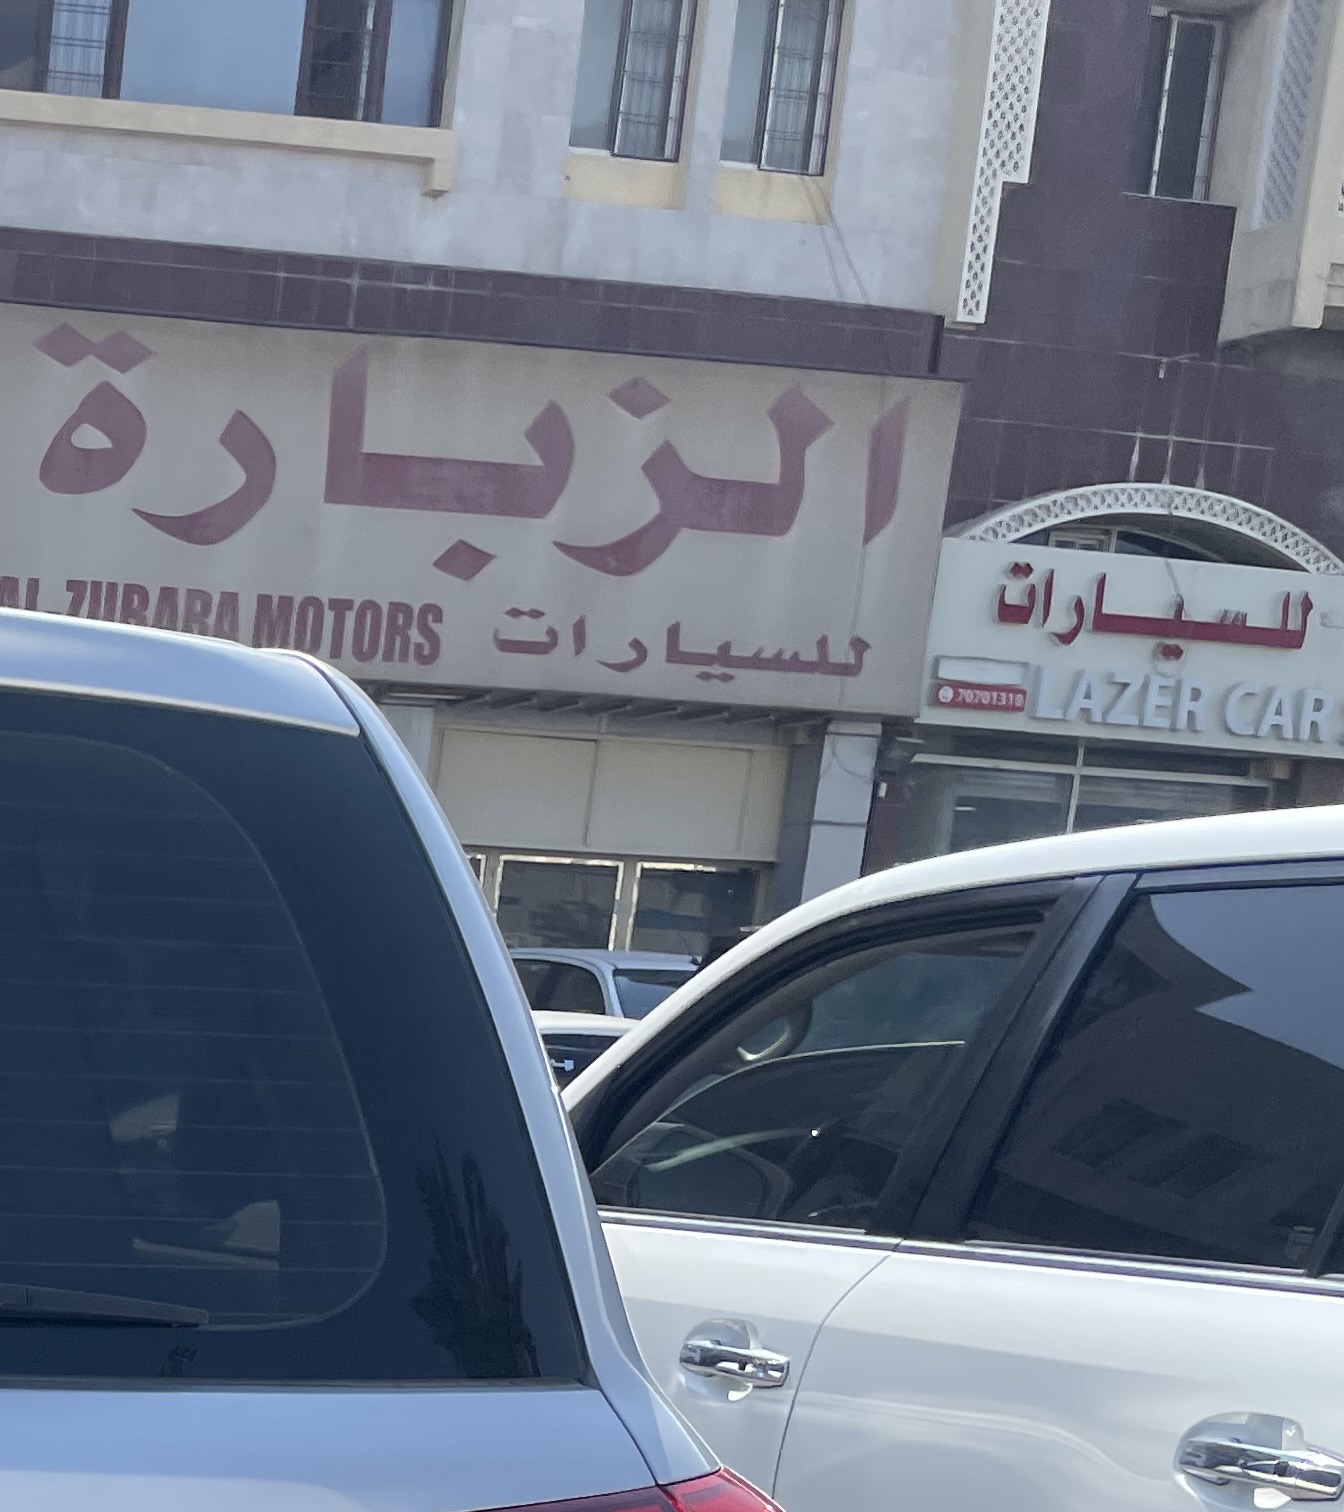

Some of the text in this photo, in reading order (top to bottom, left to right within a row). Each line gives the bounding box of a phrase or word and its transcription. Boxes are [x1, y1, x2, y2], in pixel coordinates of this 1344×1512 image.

[32, 321, 912, 582] الزبارة
[252, 592, 444, 667] MOTORS
[492, 604, 872, 682] للسيارات
[997, 561, 1314, 660] للسيارات
[1033, 664, 1344, 744] LAZER CAR
